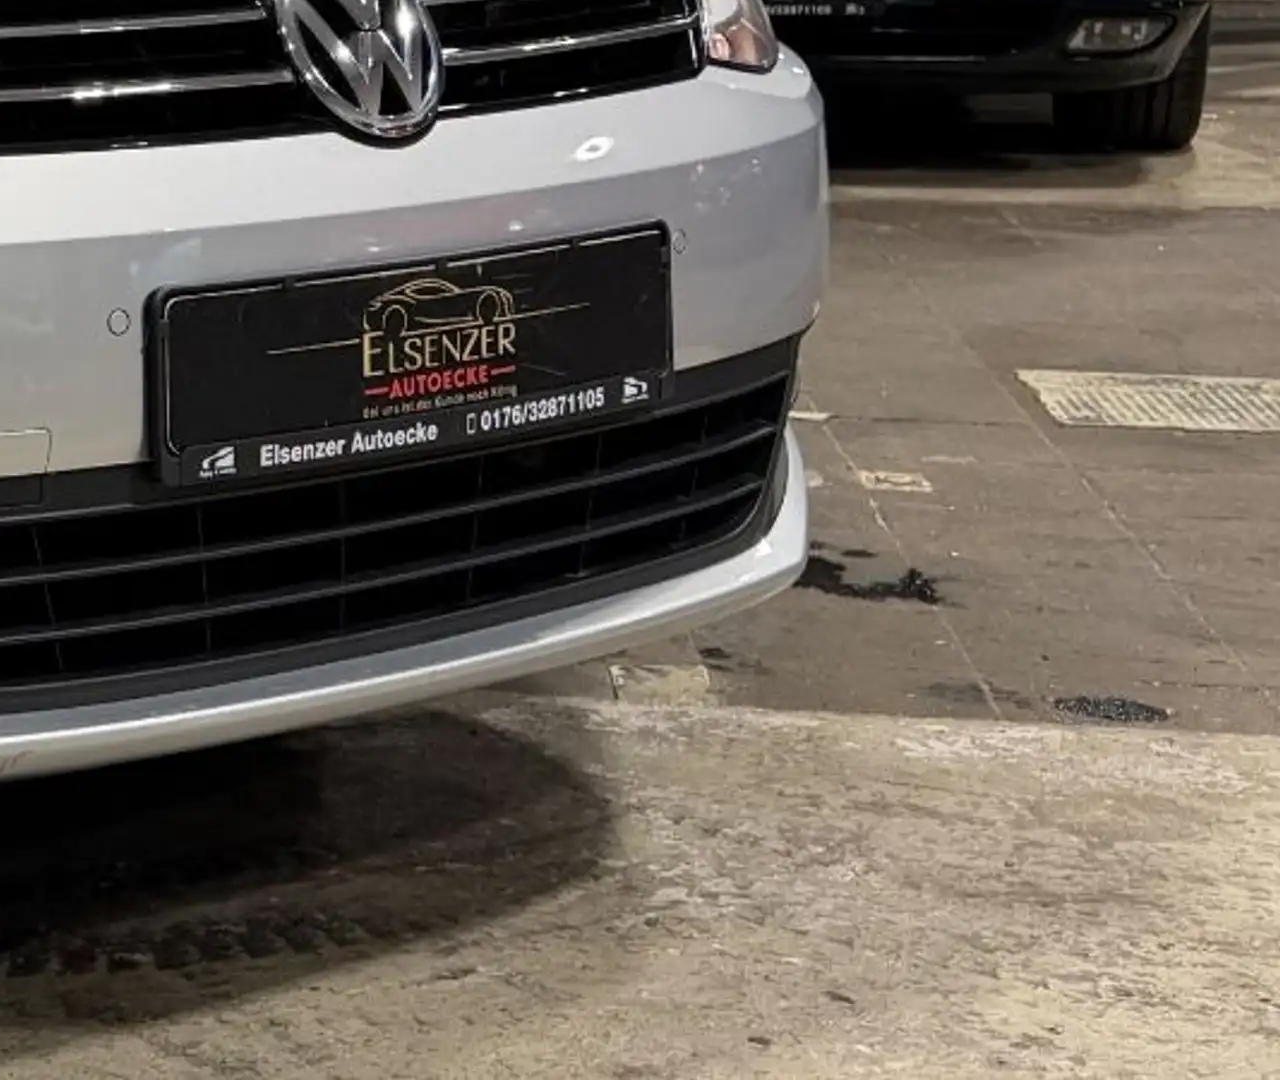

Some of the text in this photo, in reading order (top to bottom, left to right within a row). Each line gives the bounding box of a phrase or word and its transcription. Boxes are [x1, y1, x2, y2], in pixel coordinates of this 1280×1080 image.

[362, 322, 516, 377] ELSENZER
[390, 364, 489, 399] AUTOECKE
[480, 386, 605, 432] 0176/32871105
[259, 421, 438, 467] Elsenzer Autoecke
